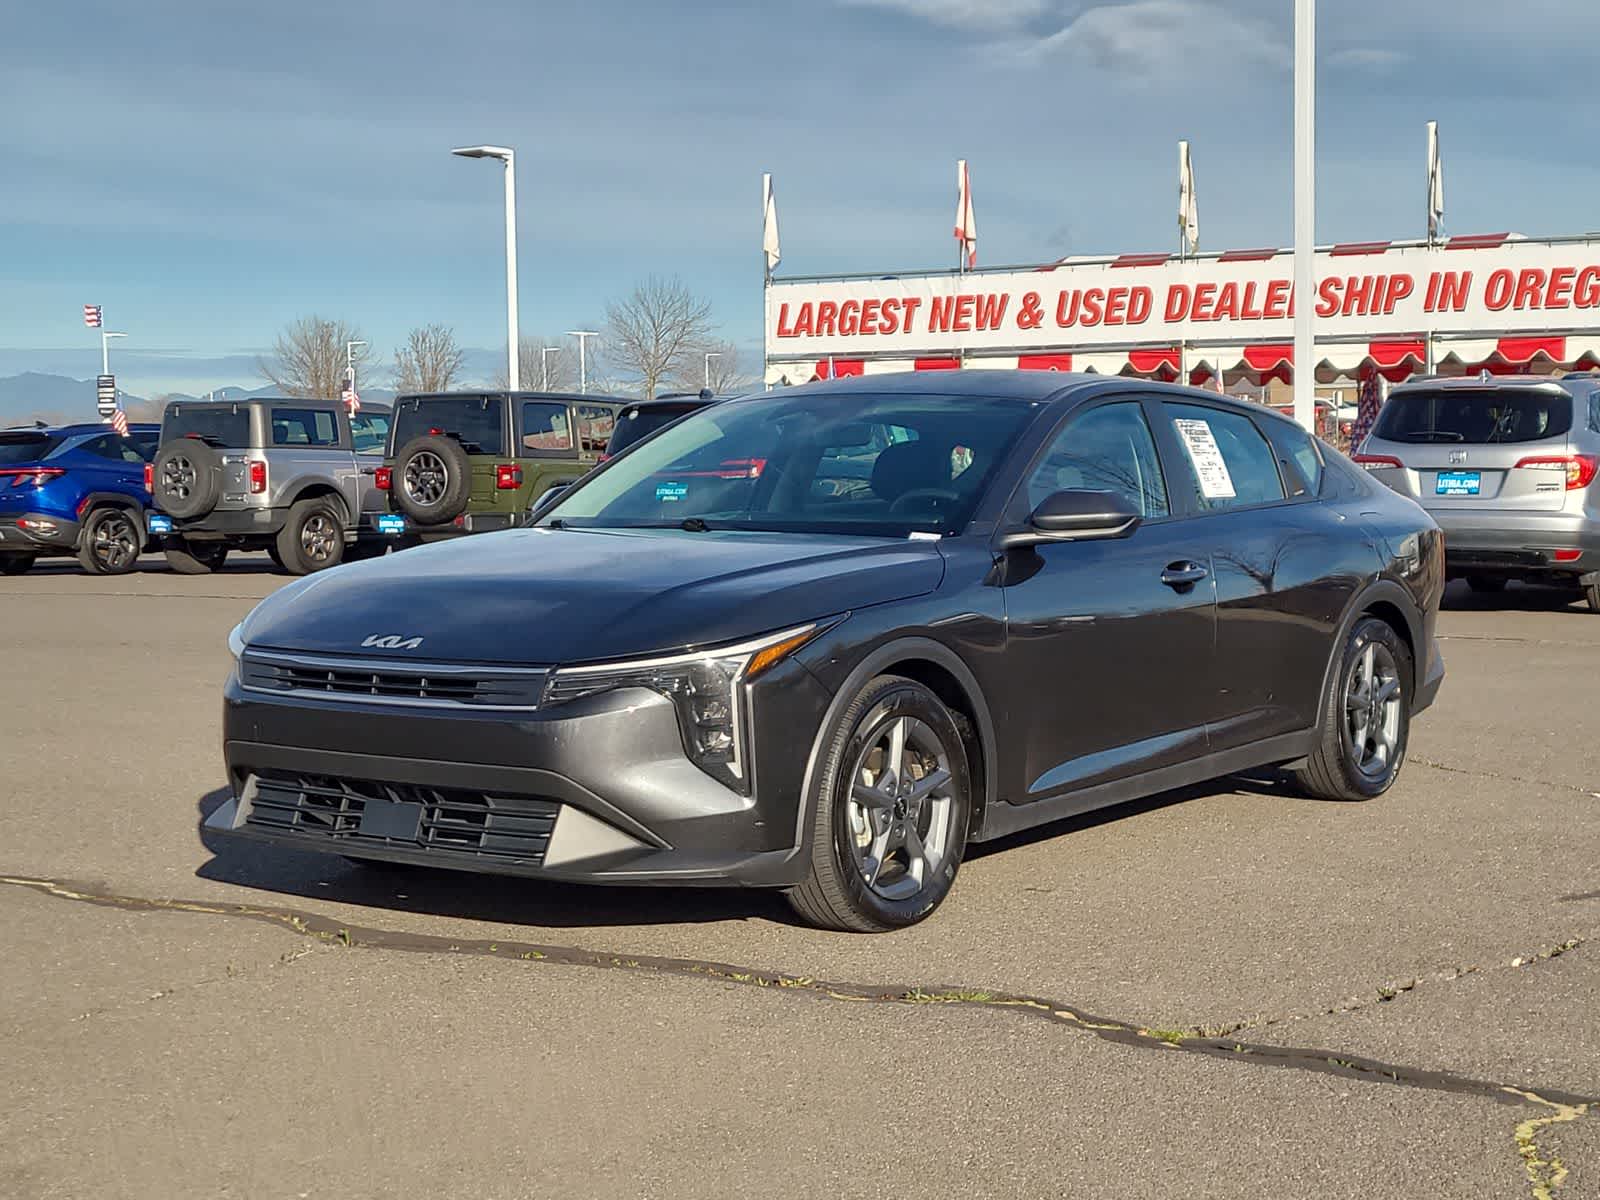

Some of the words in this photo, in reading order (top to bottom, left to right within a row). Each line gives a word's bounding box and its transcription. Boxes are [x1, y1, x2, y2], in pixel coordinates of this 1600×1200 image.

[777, 297, 921, 338] LARGEST
[928, 293, 1009, 333] NEW
[1016, 291, 1045, 329] &
[1055, 285, 1153, 328] USED
[1423, 270, 1473, 313] IN
[360, 634, 425, 650] KIA
